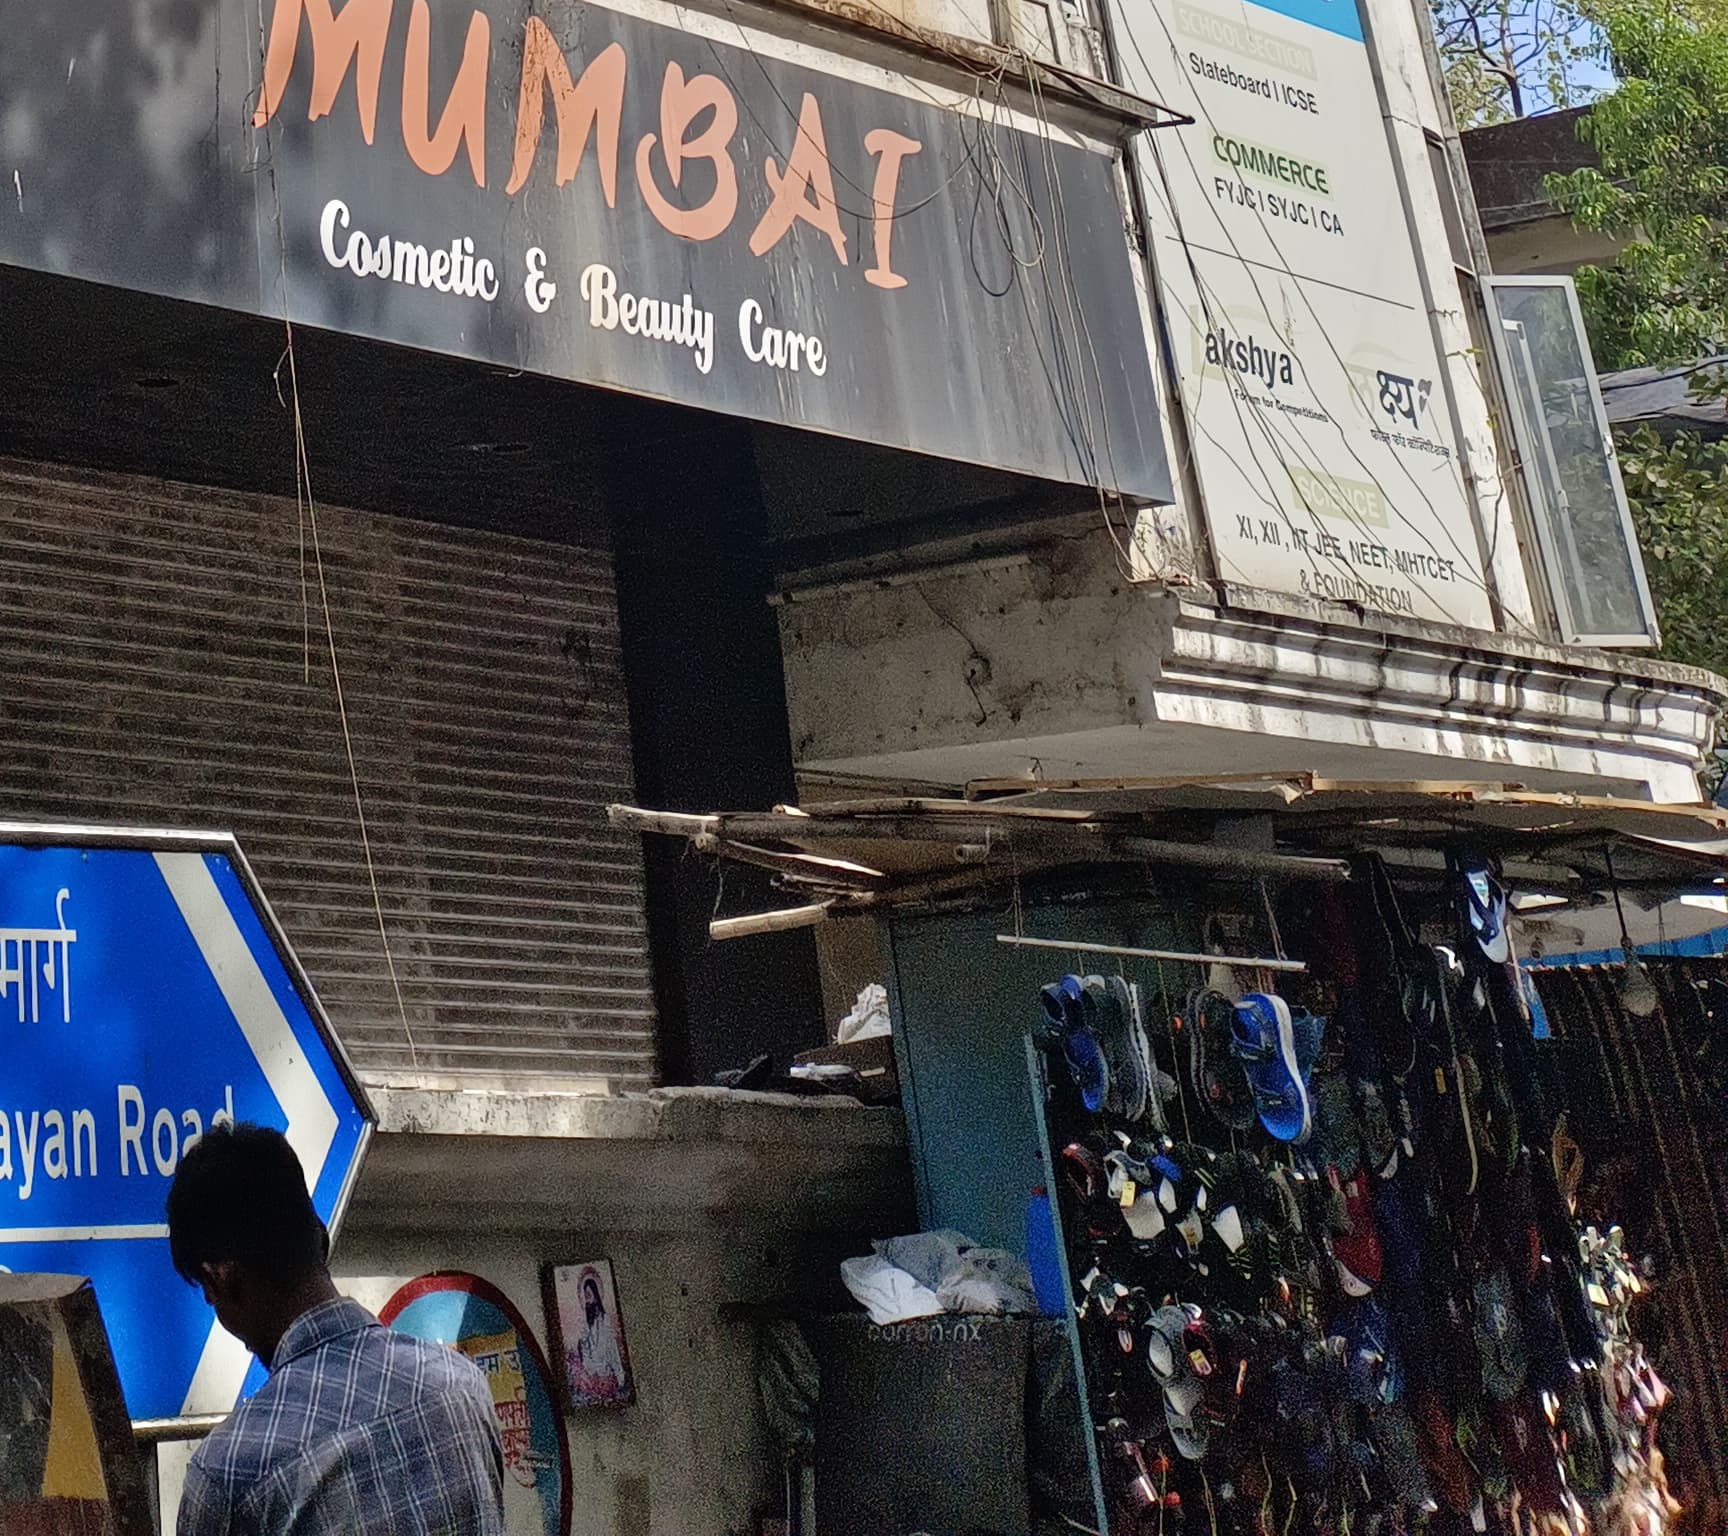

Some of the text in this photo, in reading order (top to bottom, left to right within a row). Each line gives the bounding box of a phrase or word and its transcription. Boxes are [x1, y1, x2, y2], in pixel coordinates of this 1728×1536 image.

[1178, 7, 1242, 46] SCHOOL
[1188, 50, 1320, 116] Stateboard ICSE
[1212, 134, 1330, 195] COMMERCE
[1213, 176, 1345, 237] FYJC SYJC CA
[319, 198, 827, 376] Cosmetic & Beauty Care
[1235, 513, 1259, 546] XI,
[1395, 548, 1456, 583] MHTCET
